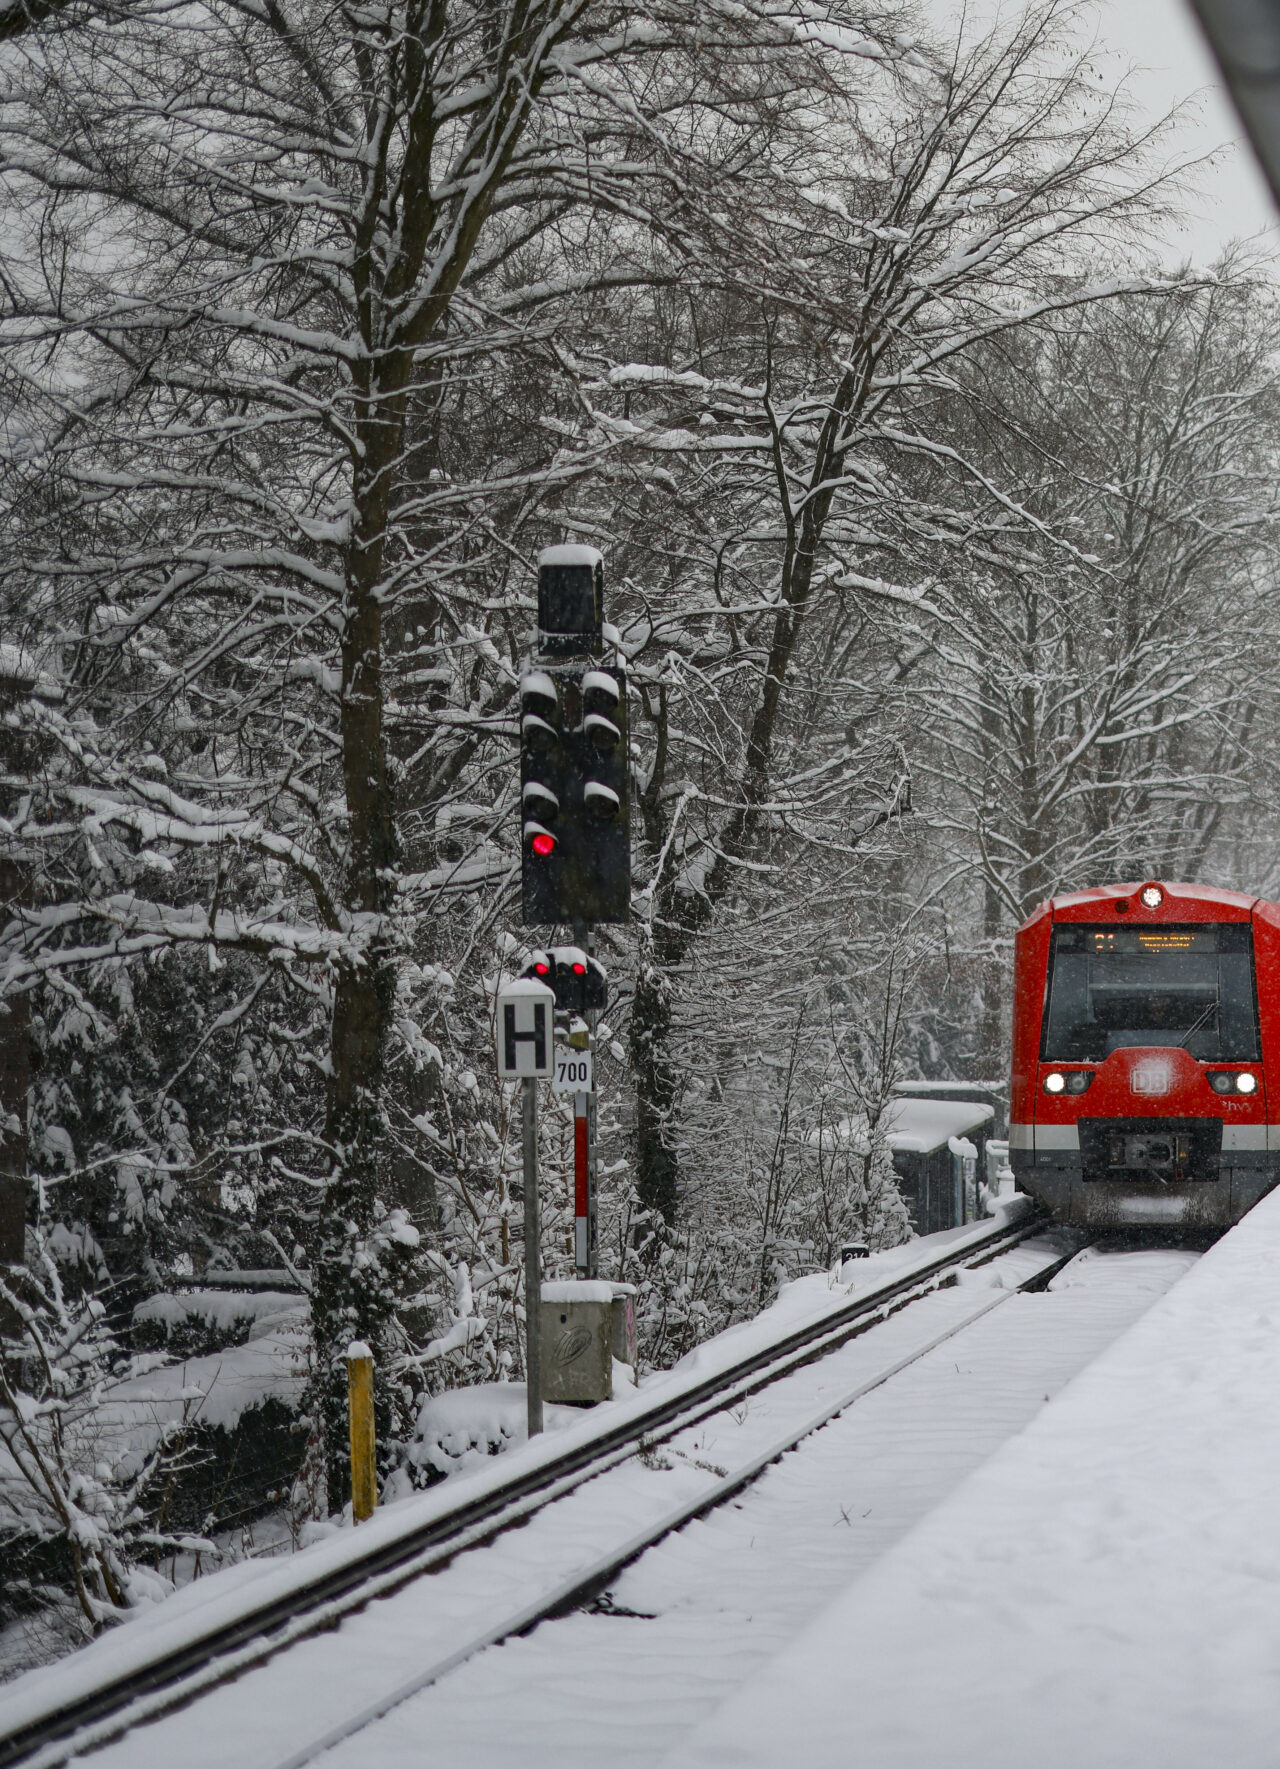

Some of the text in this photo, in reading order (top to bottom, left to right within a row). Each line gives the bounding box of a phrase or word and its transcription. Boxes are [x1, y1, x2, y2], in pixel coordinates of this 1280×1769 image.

[504, 1004, 547, 1070] H
[557, 1062, 588, 1083] 700
[1134, 1071, 1166, 1091] DB
